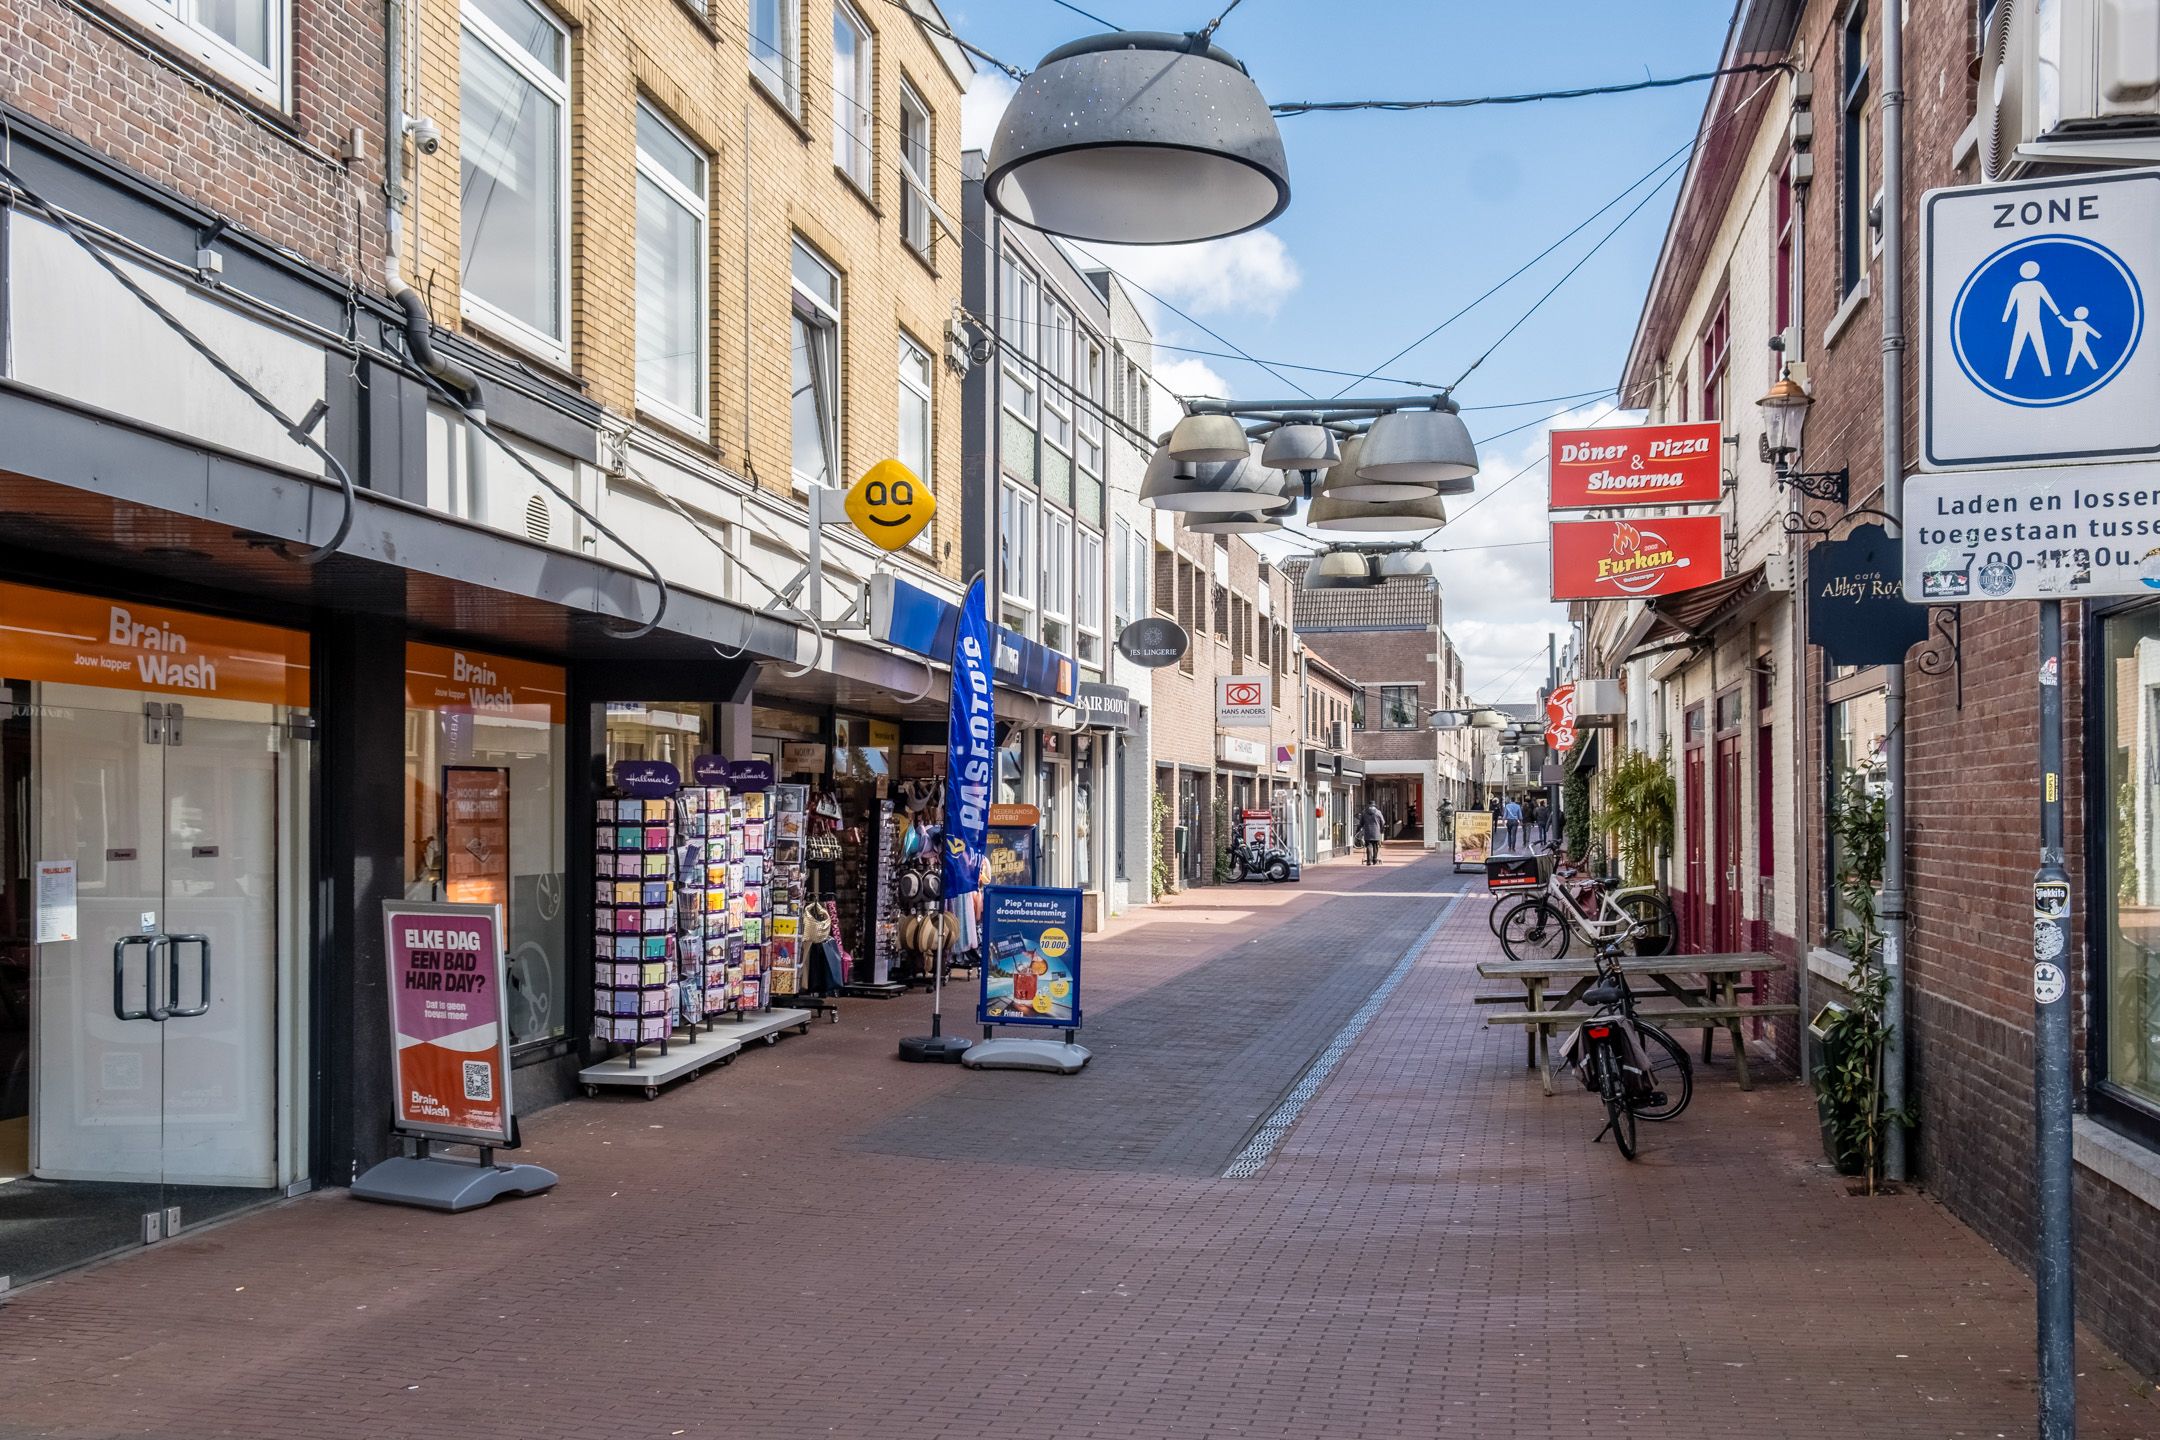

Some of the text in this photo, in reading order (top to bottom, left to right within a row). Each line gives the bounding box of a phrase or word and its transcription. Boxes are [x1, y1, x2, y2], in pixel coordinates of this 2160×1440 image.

[1993, 195, 2099, 229] ZONE
[1560, 437, 1710, 470] Döner & Pizza
[1587, 469, 1685, 491] Shoarma
[1938, 494, 2017, 516] Laden
[2029, 495, 2061, 512] en
[1919, 523, 2077, 548] toegestaan
[1597, 549, 1675, 578] Furkan
[1855, 571, 1881, 580] café
[1821, 576, 1866, 605] Abbey
[109, 606, 186, 654] Brain
[74, 653, 132, 672] Jouw kapper
[1130, 648, 1177, 657] JES LINGERIE
[137, 655, 217, 691] Wash
[453, 652, 497, 686] Brain
[469, 686, 514, 713] Wash
[960, 636, 989, 831] PASFOTO'S
[626, 772, 674, 787] Hallmark
[697, 766, 727, 777] Hallmark
[729, 772, 769, 784] Hallmark
[991, 850, 1016, 865] 120
[996, 907, 1067, 918] droombestemming
[1004, 899, 1022, 908] Piep
[1050, 900, 1059, 910] je
[404, 929, 480, 951] ELKE DAG
[411, 950, 477, 972] EEN BAD
[405, 971, 486, 993] HAIR DAY?
[424, 1010, 468, 1020] toeval meer
[426, 1000, 466, 1012] Dat is geen
[411, 1091, 438, 1105] Brain
[421, 1105, 450, 1117] Wash
